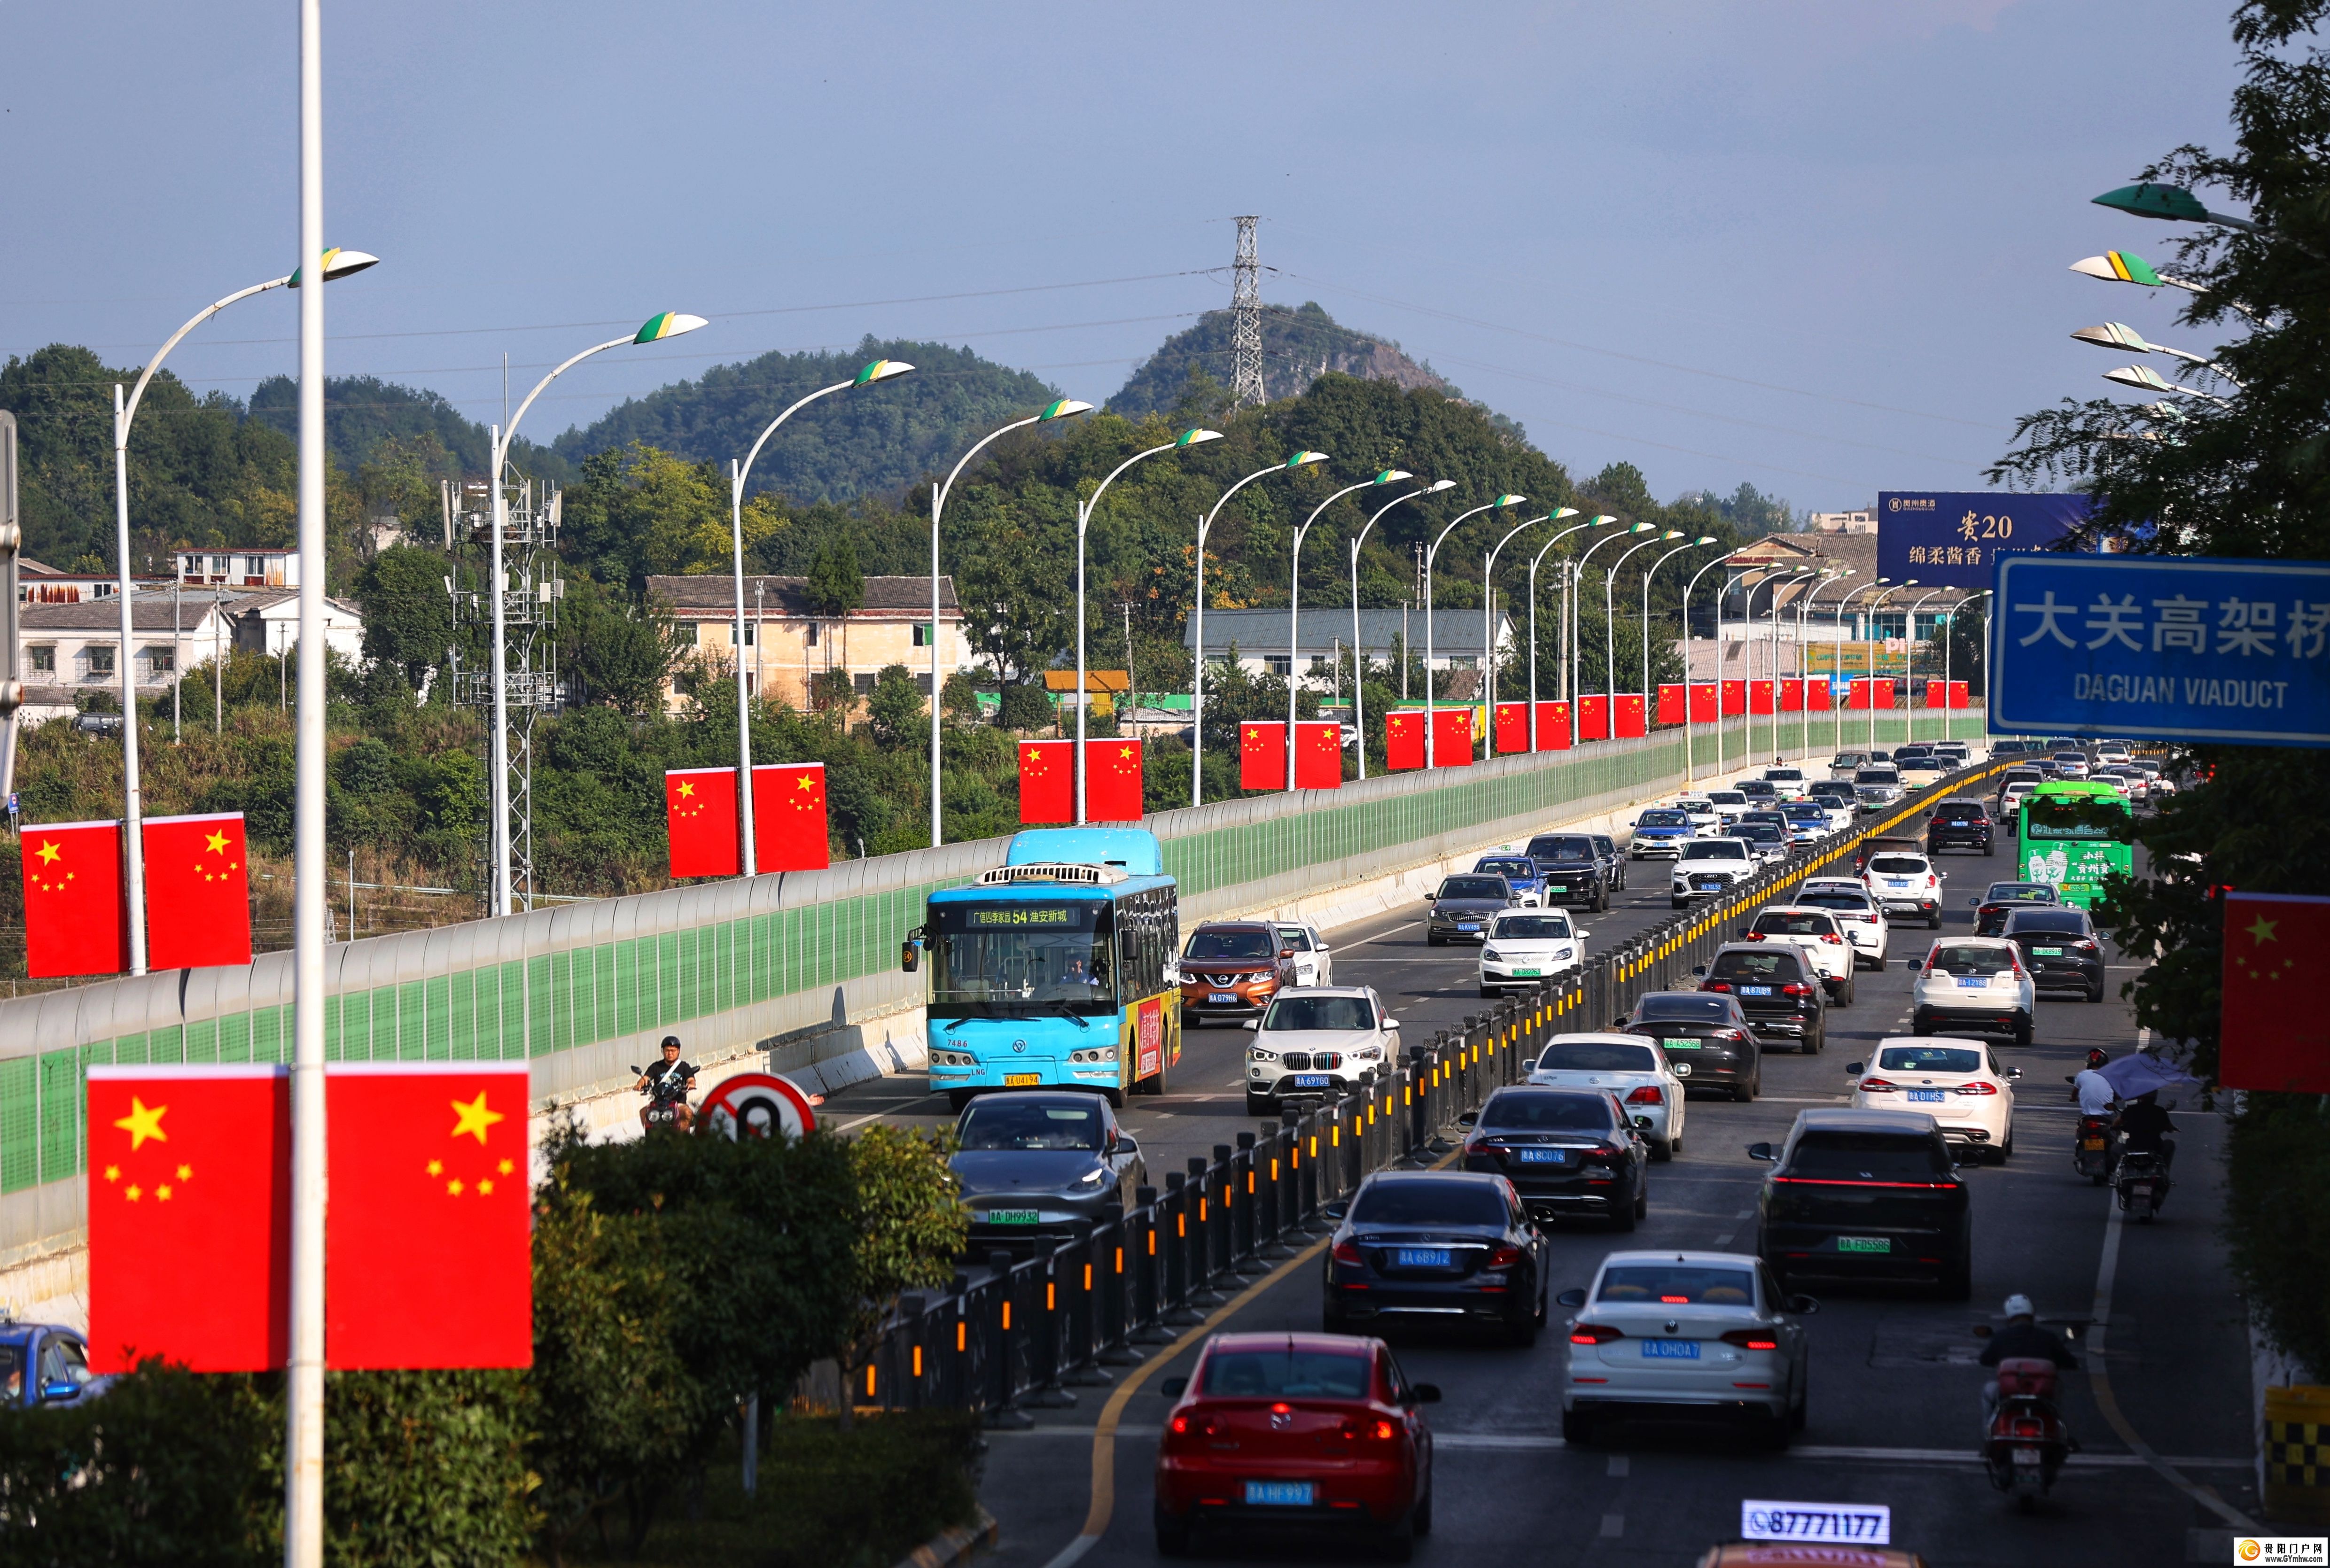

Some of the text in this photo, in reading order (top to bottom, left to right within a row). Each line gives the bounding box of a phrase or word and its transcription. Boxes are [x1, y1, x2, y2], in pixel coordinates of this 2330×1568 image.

[1903, 499, 1936, 507] 贵州贵酒
[1909, 546, 1982, 565] 绵柔酱香
[2014, 590, 2330, 659] 大关高架桥
[2073, 673, 2289, 708] DAGUAN VIADUCT
[973, 909, 1067, 924] 广信四季家园 54 渔安新城
[947, 1039, 968, 1048] 7486
[1770, 1511, 1882, 1537] 87771177
